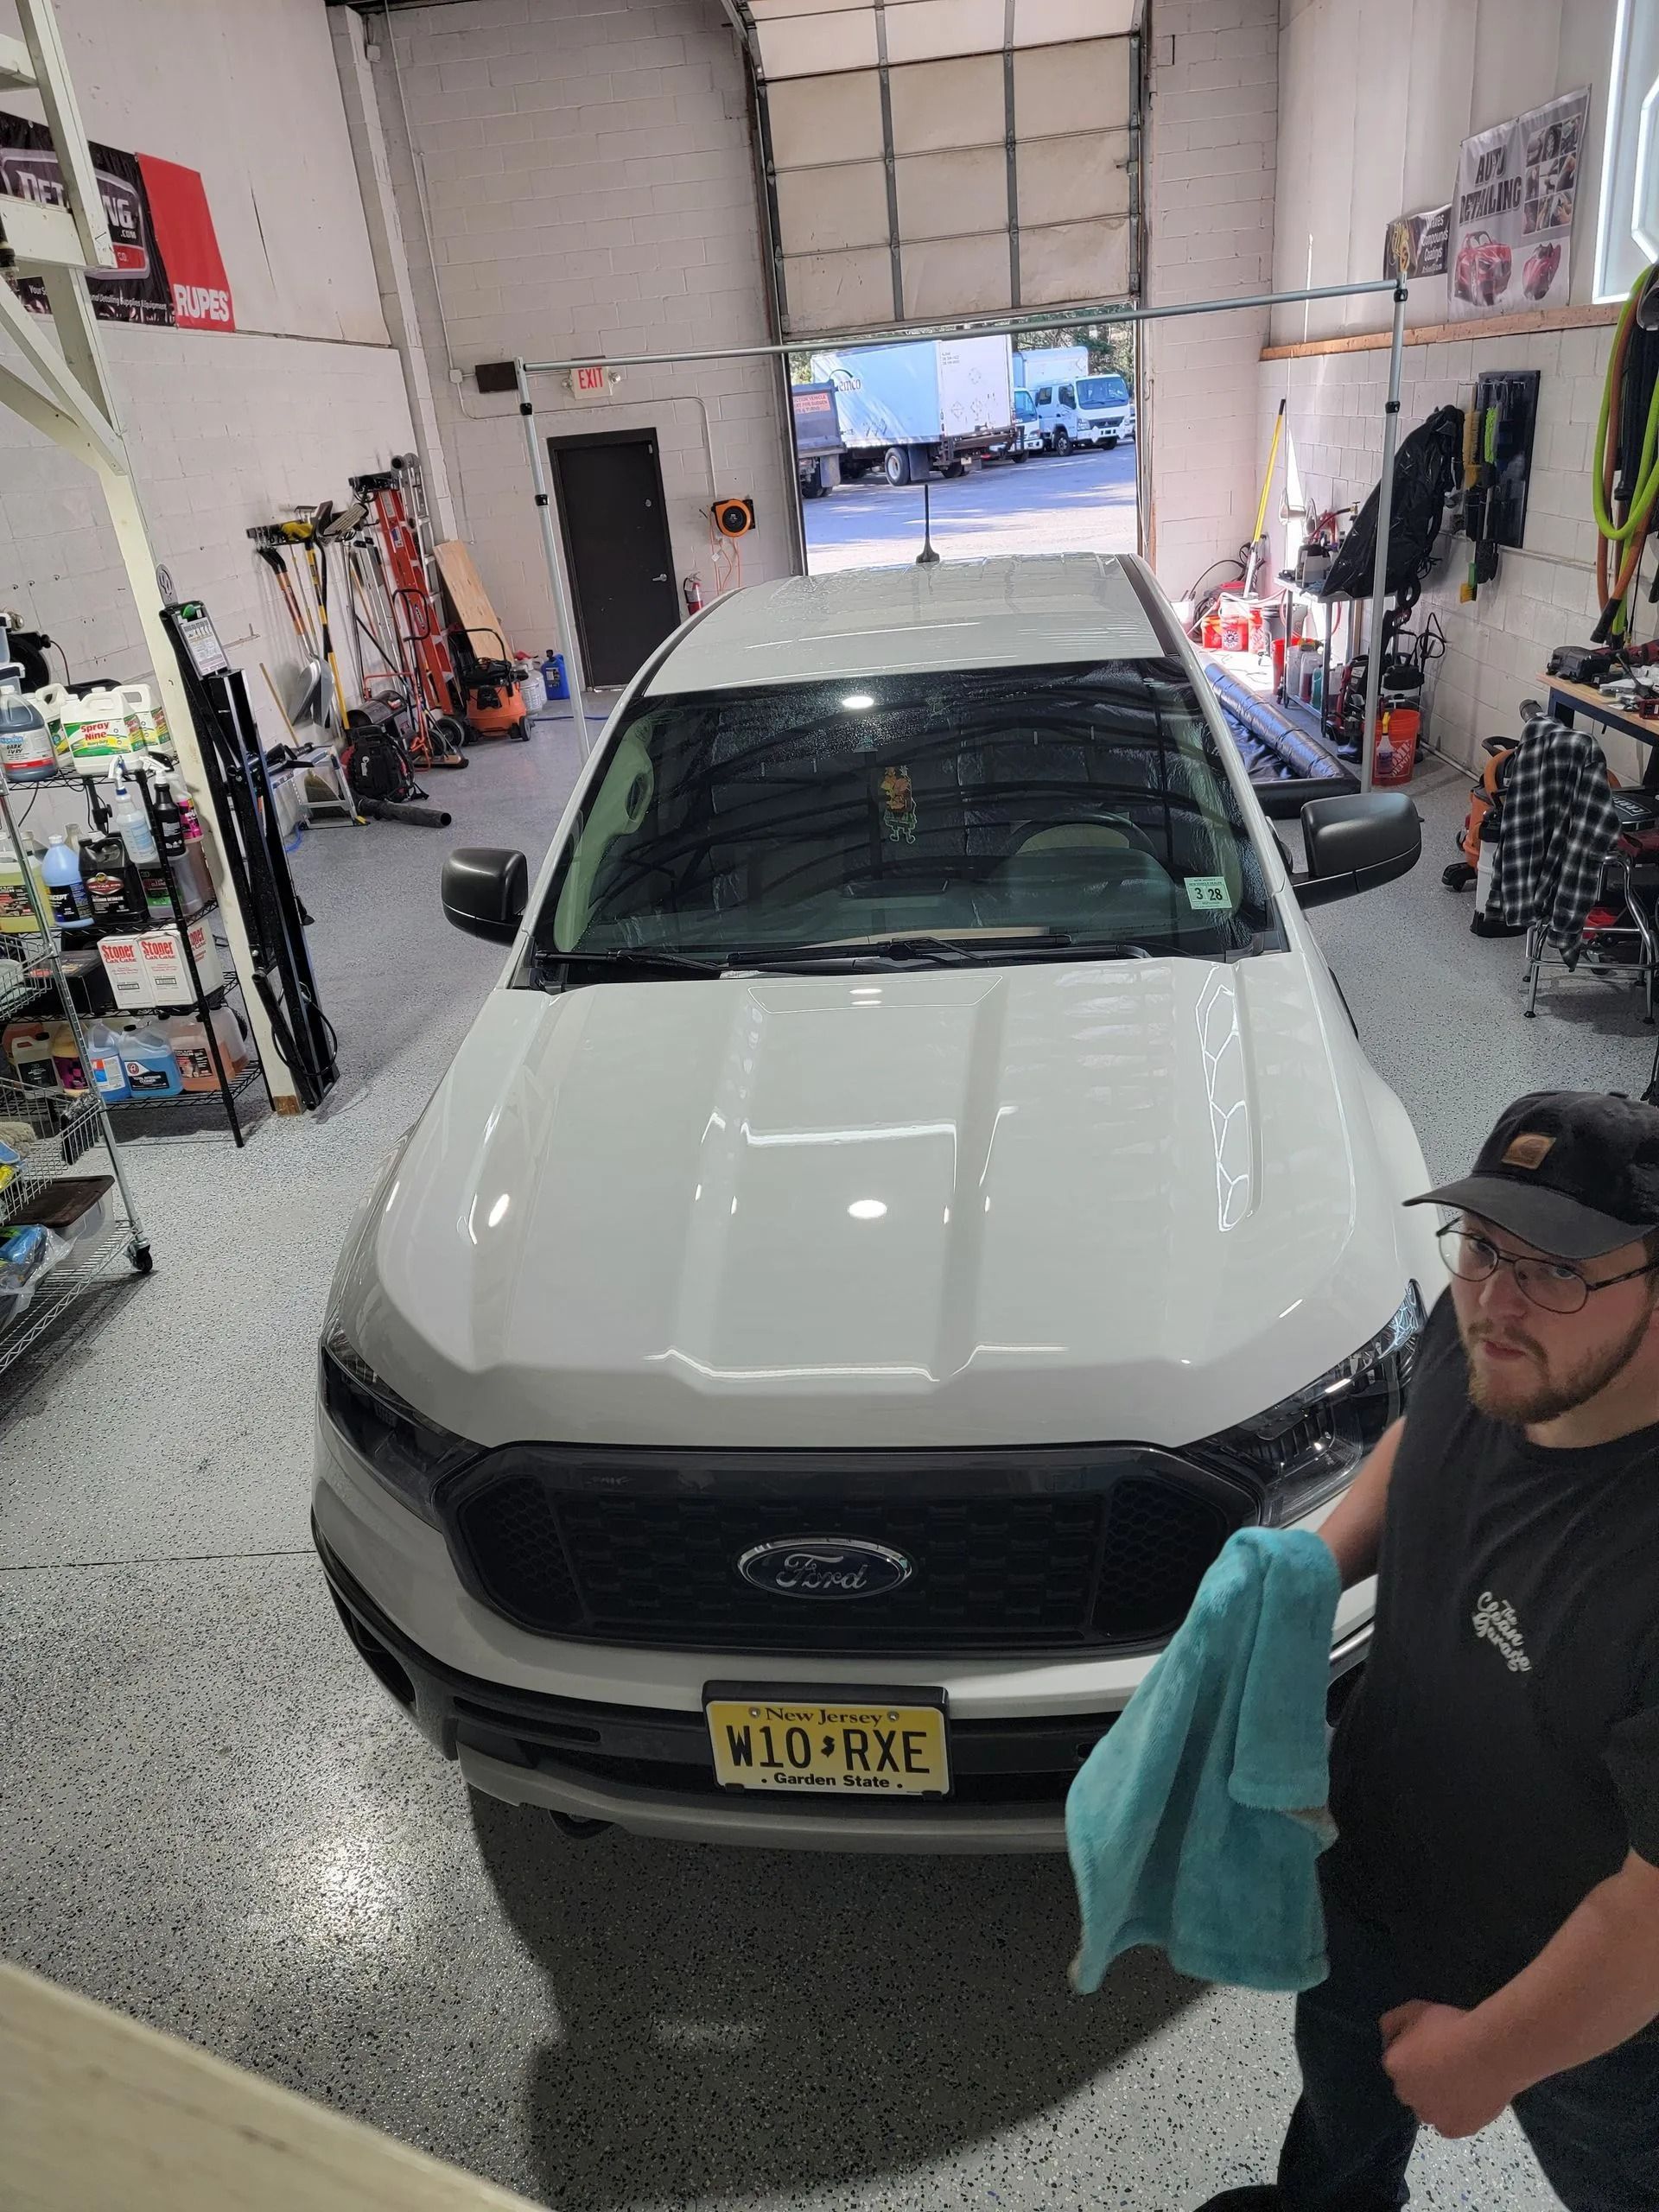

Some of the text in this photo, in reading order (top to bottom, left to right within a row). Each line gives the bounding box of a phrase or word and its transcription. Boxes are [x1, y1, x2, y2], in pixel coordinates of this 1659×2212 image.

[1474, 144, 1506, 186] AUTO
[16, 170, 137, 229] DETNG
[1459, 175, 1522, 226] DETAILING
[1421, 229, 1449, 247] Compounds
[29, 284, 41, 295] Your
[99, 293, 119, 307] Detailing
[119, 296, 141, 309] Supplies
[173, 283, 230, 323] RUPES
[578, 367, 603, 389] EXIT
[838, 378, 861, 391] emco
[80, 721, 110, 733] Spray
[85, 731, 107, 741] Nine
[1194, 887, 1224, 901] 3 28
[189, 927, 205, 945] oner
[101, 944, 135, 960] Stoner
[141, 940, 175, 956] Stoner
[776, 1553, 870, 1590] Ford
[1477, 1591, 1525, 1647] Clean
[1502, 1599, 1518, 1625] The
[765, 1707, 883, 1727] New Jersey
[726, 1724, 931, 1774] W10 RXE
[772, 1771, 890, 1789] Garden State
